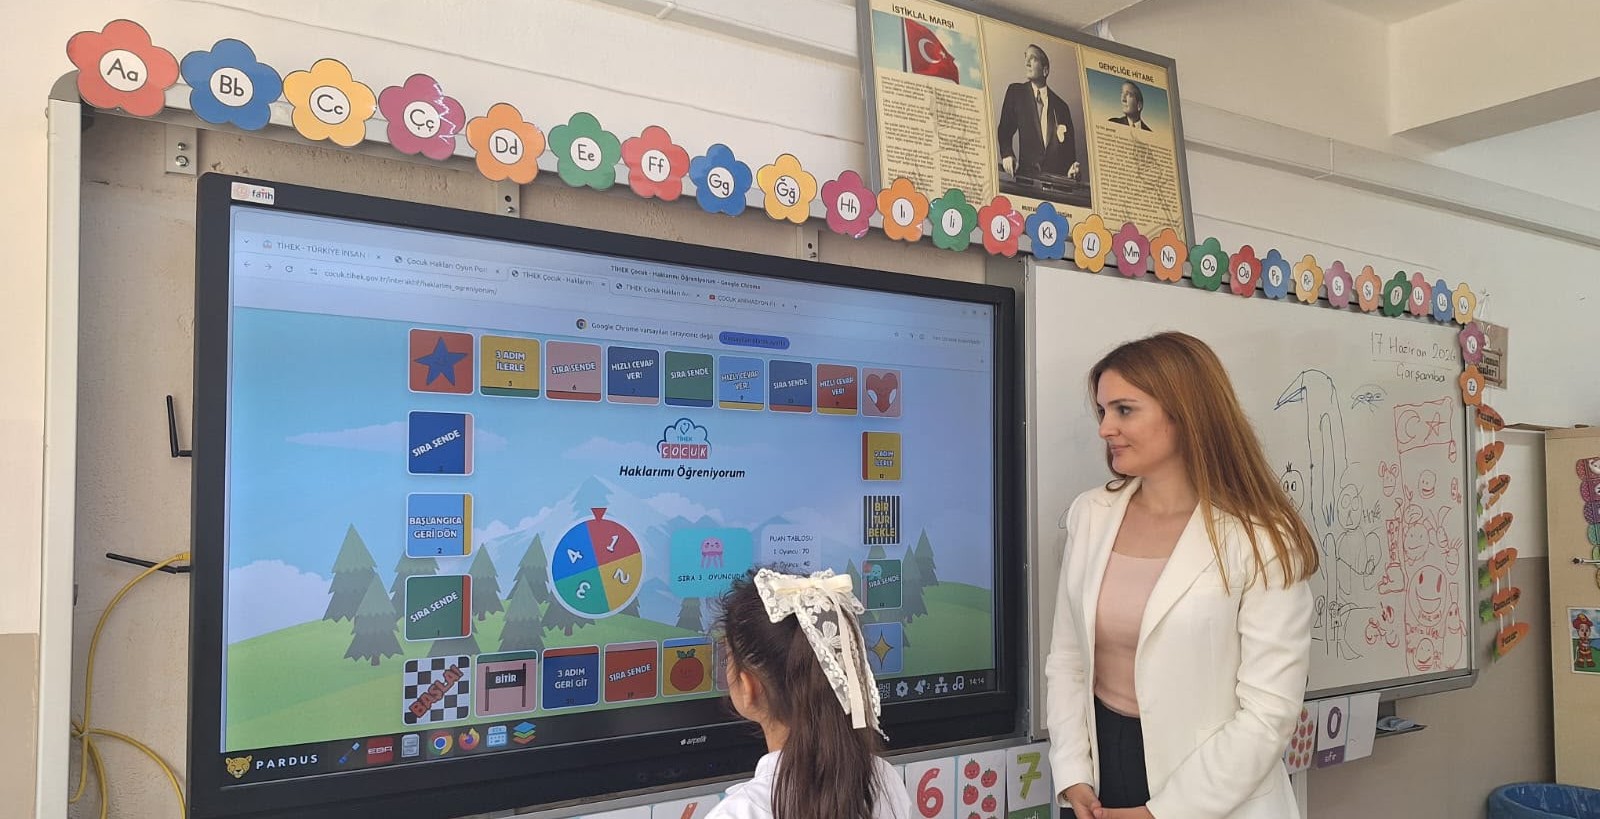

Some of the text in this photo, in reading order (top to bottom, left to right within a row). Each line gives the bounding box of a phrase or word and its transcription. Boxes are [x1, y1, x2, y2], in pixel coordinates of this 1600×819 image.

[891, 4, 929, 23] İSTİKLAL
[106, 57, 139, 82] Aa
[219, 74, 245, 97] Bb
[316, 93, 344, 115] Cc
[409, 108, 435, 132] Çç
[494, 136, 518, 156] Dd
[576, 143, 596, 163] Ee
[648, 156, 665, 174] Ff
[708, 173, 730, 196] Gg
[776, 178, 796, 204] Ğğ
[840, 198, 857, 214] Hh
[996, 220, 1006, 240] Jj
[1042, 226, 1054, 241] Kk
[307, 243, 341, 258] TÜRKİYE
[1123, 246, 1140, 258] Mm
[1162, 247, 1175, 263] Nn
[406, 255, 428, 268] Çocuk
[455, 261, 475, 273] Oyun
[1202, 258, 1216, 272] Oo
[1271, 269, 1280, 284] Pp
[591, 320, 614, 332] Google
[614, 322, 640, 334] Chrome
[1370, 330, 1384, 355] 17
[1389, 335, 1428, 358] Haziran
[495, 350, 526, 362] 3 ADIM
[495, 361, 525, 373] İLERLE
[551, 361, 597, 375] SIRA SENDE
[611, 359, 655, 372] HIZLI CEVAP
[1396, 362, 1446, 383] Çarşamba
[626, 372, 643, 381] VER!
[670, 367, 710, 380] SIRA SENDE
[773, 378, 809, 390] SIRA SENDE
[819, 376, 854, 388] HIZLI CEVAP
[411, 429, 462, 458] SIRA SENDE
[676, 435, 693, 443] TİHEK
[662, 445, 707, 458] ÇOCUK
[619, 464, 746, 481] Haklarımı Öğreniyorum
[409, 516, 463, 527] BAŞLANGICA
[413, 528, 458, 539] GERİ DÖN
[769, 534, 814, 543] PUAN TABLOSU
[868, 527, 896, 538] BEKLE
[606, 533, 619, 554] 1
[801, 547, 810, 555] 70
[567, 547, 583, 564] 4
[612, 567, 631, 585] 2
[677, 575, 696, 583] SIRA
[868, 574, 900, 589] SIRA SENDE
[575, 581, 591, 600] 3
[410, 591, 459, 623] SIRA SENDE
[495, 673, 517, 685] BİTİR
[557, 667, 586, 679] 3 ADIM
[608, 663, 652, 683] SIRA SENDE
[554, 677, 589, 690] GERİ GİT
[926, 682, 931, 690] 2
[969, 677, 985, 686] 14:14
[1326, 705, 1343, 740] 0
[367, 746, 393, 756] EBA
[255, 754, 319, 771] PARDUS
[1016, 751, 1042, 800] 7
[916, 766, 944, 819] 6
